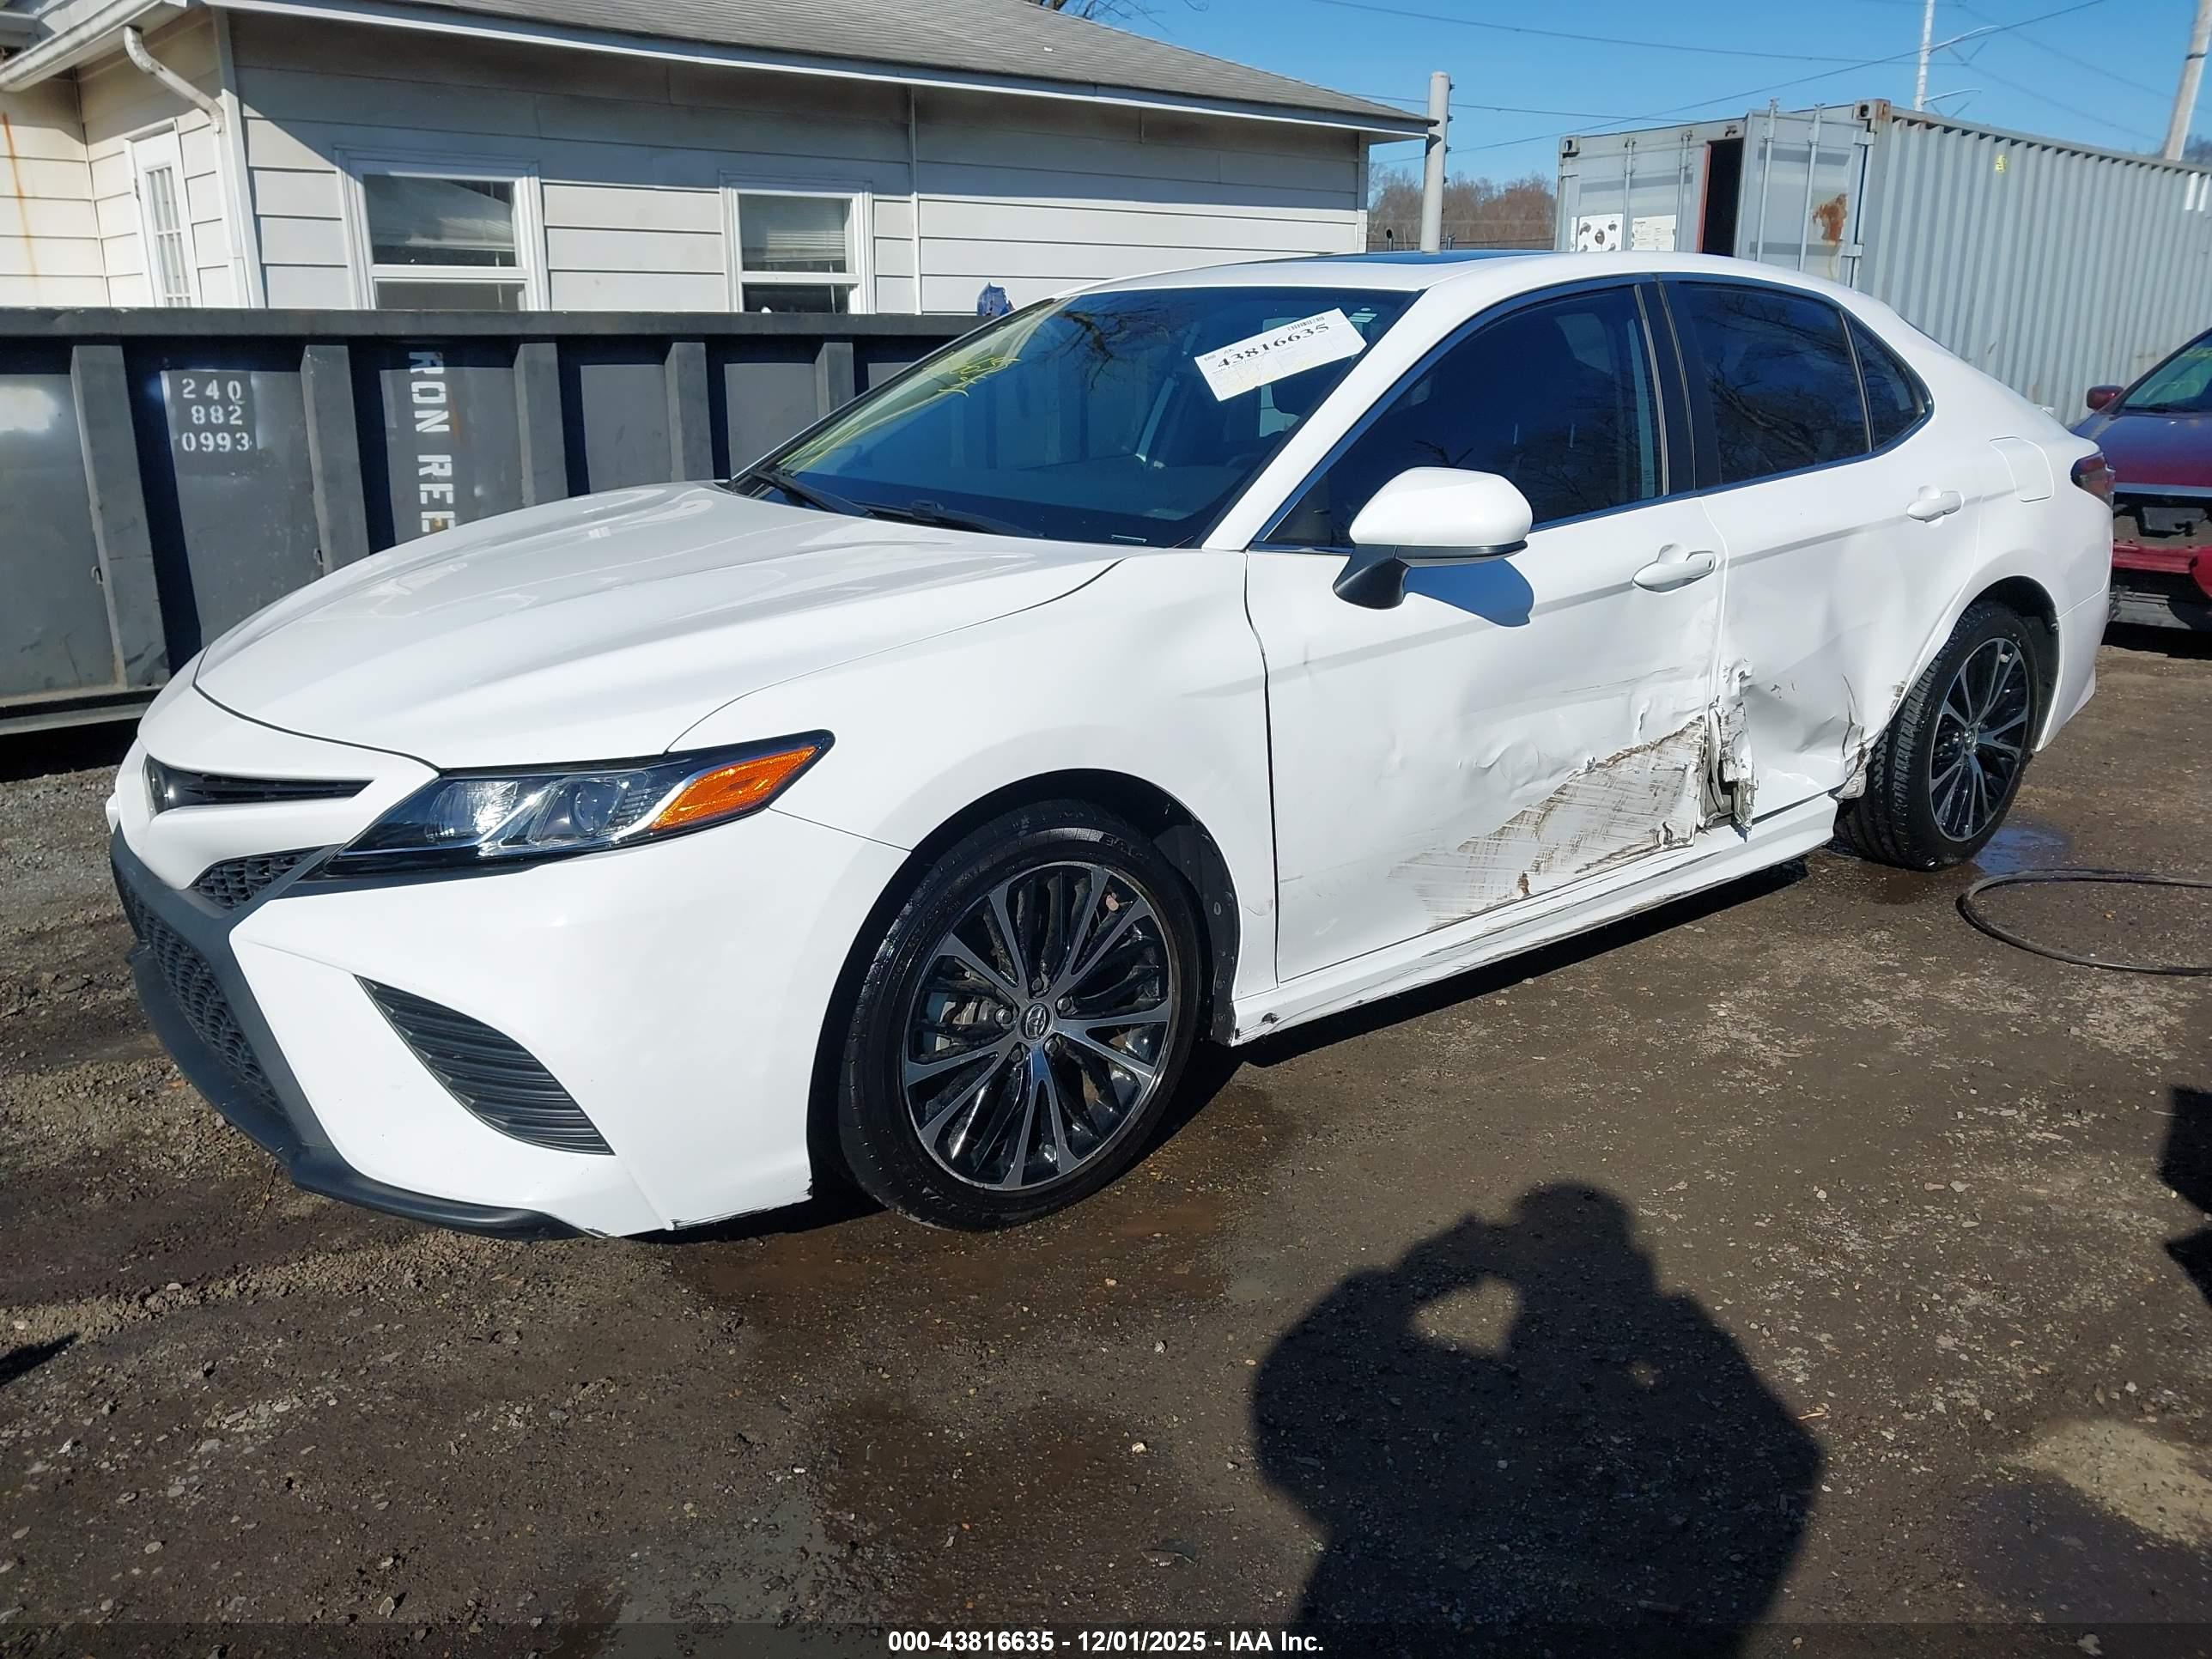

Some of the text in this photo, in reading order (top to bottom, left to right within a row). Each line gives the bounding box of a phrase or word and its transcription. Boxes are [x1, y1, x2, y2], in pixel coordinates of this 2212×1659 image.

[1218, 323, 1329, 368] 43816635
[191, 405, 243, 425] 882
[181, 432, 250, 453] 0993
